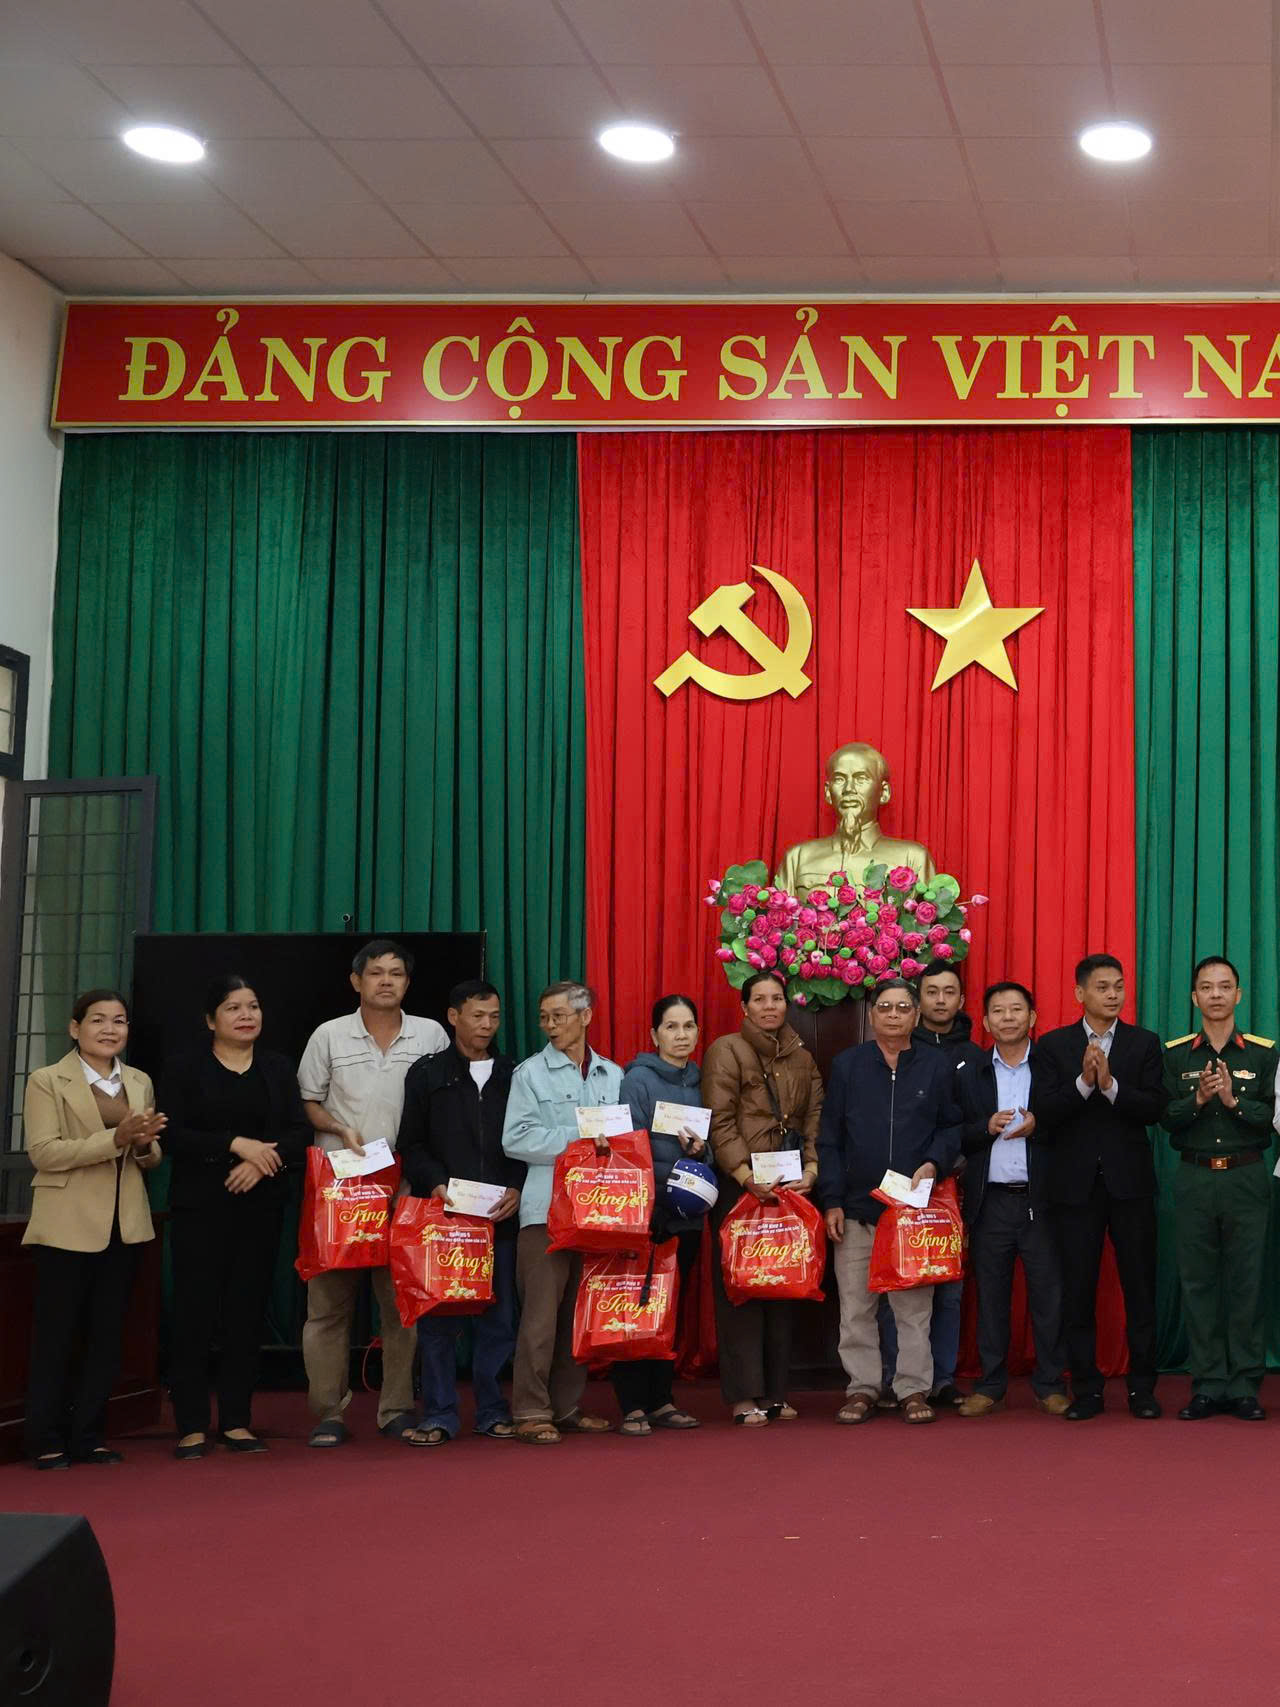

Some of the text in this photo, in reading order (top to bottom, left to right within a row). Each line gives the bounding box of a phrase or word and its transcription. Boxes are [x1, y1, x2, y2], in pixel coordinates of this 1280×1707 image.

[118, 307, 391, 403] ĐẢNG
[422, 317, 689, 419] CỘNG
[718, 307, 908, 402] SẢN
[931, 315, 1156, 418] VIỆT
